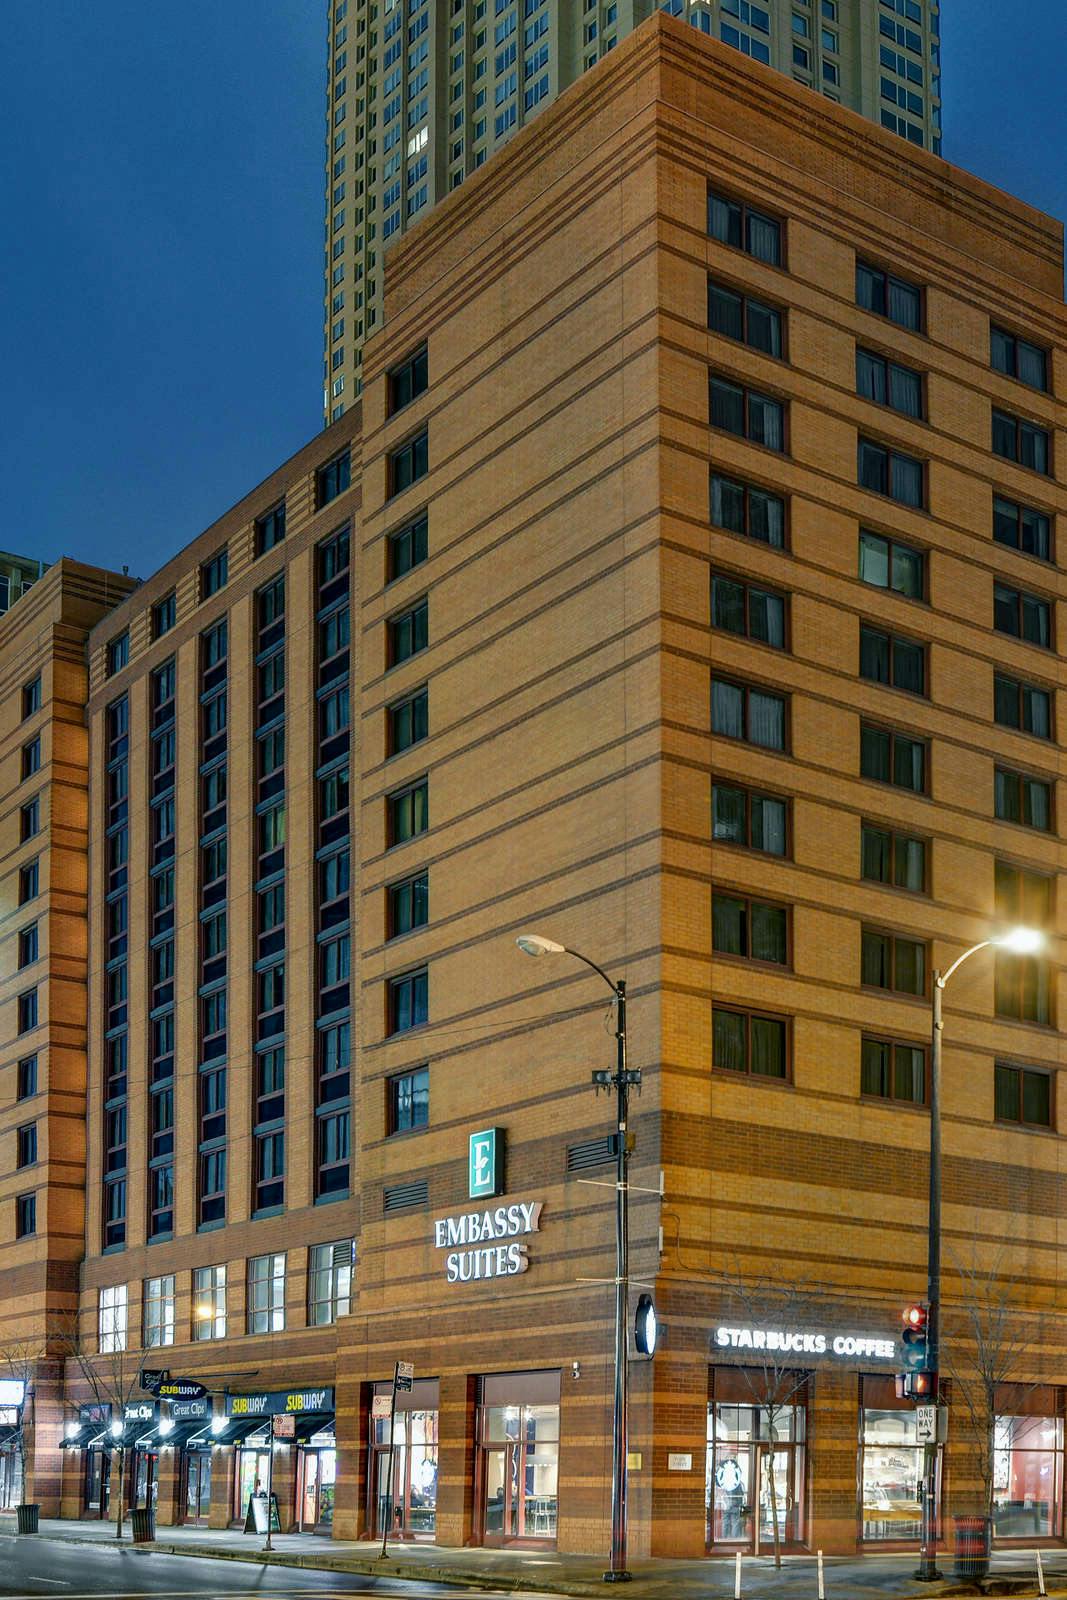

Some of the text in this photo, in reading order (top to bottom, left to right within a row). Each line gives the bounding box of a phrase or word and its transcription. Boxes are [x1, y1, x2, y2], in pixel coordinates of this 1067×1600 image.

[474, 1141, 490, 1186] E
[435, 1202, 541, 1248] EMBASSY
[447, 1243, 526, 1283] SUITES
[717, 1327, 895, 1358] STARBUCKS COFFEE
[159, 1385, 201, 1395] SUBWAY
[173, 1402, 205, 1416] Great Clips
[231, 1396, 267, 1413] SUBWAY
[286, 1391, 325, 1411] SUBWAY
[139, 1405, 153, 1420] Clips
[918, 1408, 933, 1418] ONE
[918, 1419, 933, 1428] WAY
